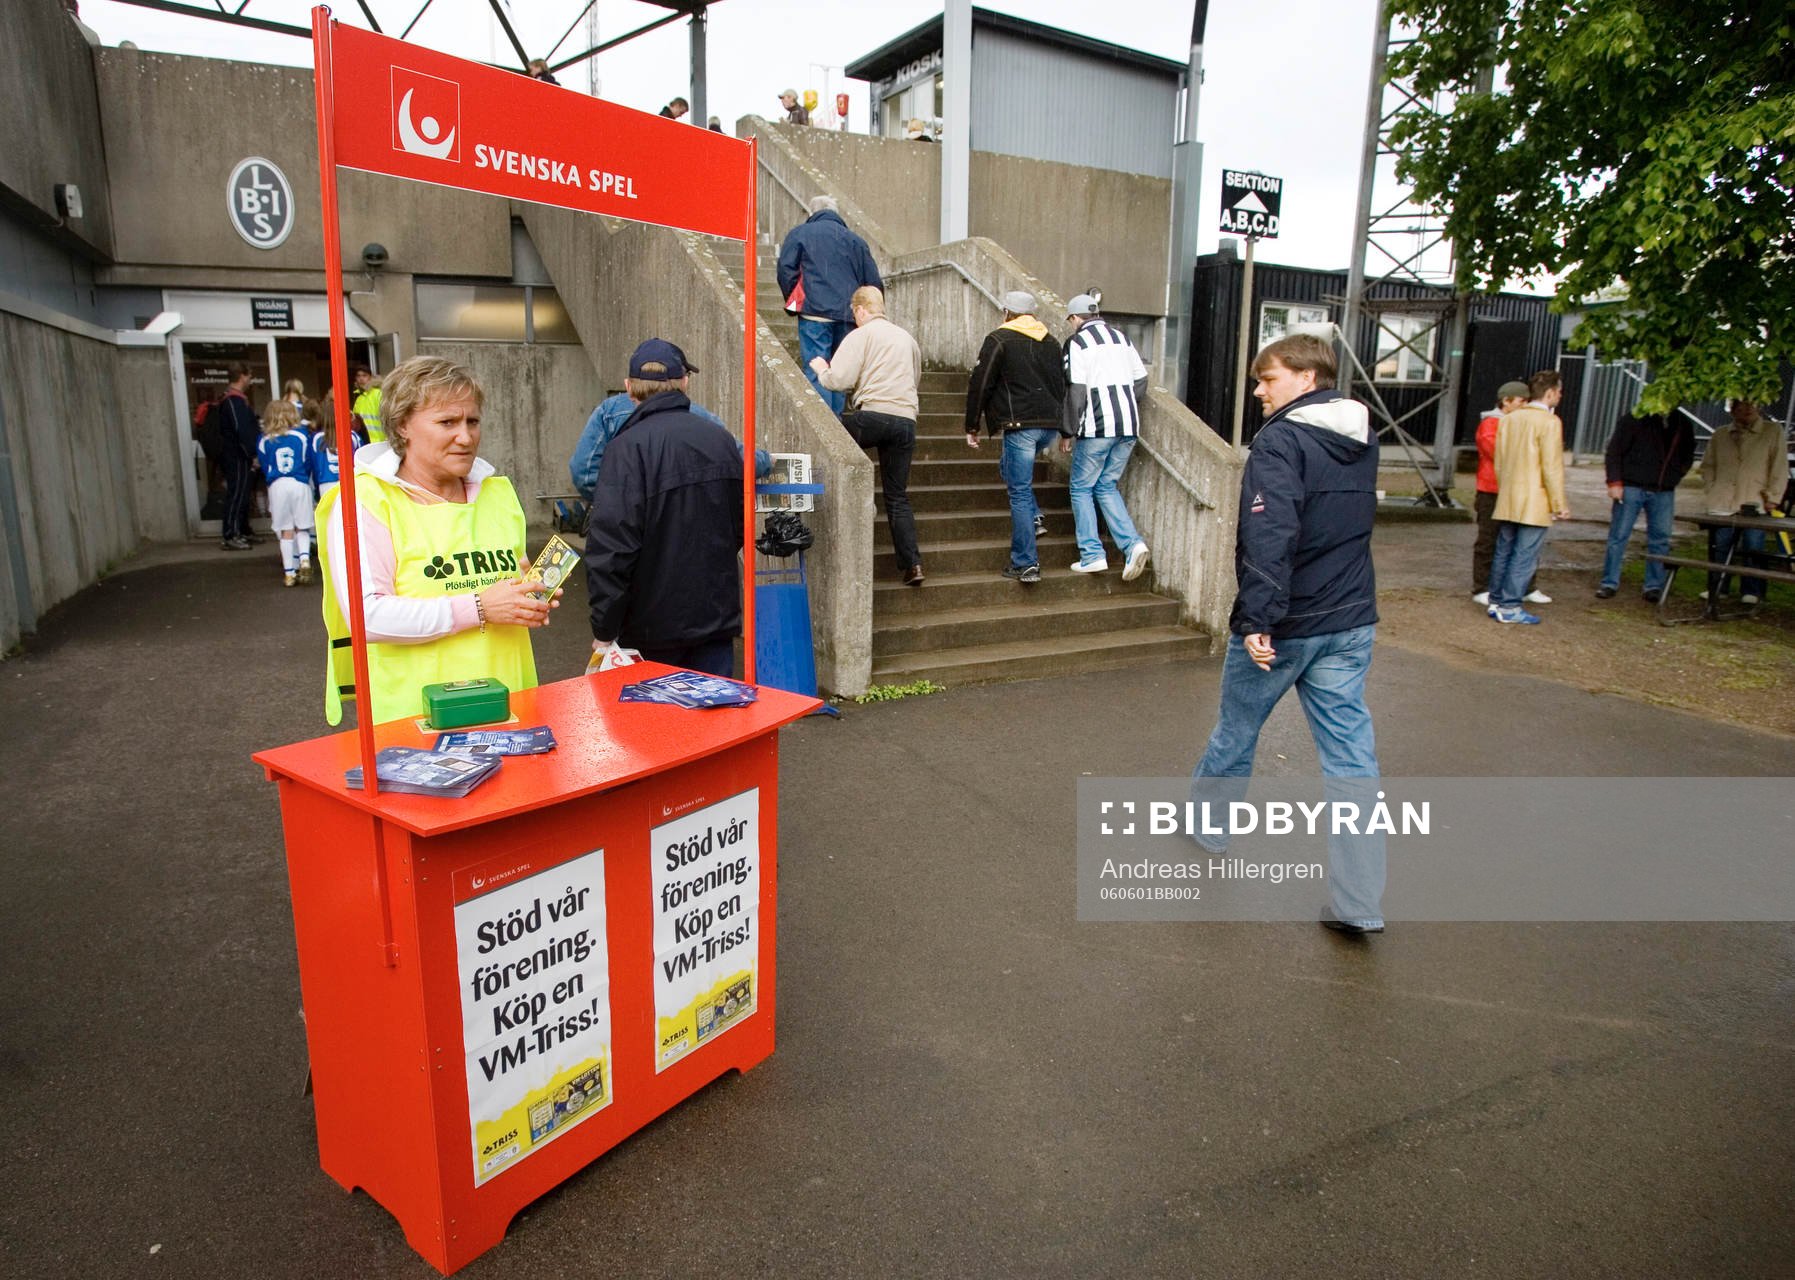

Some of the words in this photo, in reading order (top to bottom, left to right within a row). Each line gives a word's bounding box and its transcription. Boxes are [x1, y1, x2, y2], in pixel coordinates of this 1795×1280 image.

[896, 48, 944, 85] KIOSK
[474, 143, 582, 188] SVENSKA
[589, 169, 638, 199] SPEL
[1225, 171, 1280, 194] SEKTION
[1220, 208, 1279, 236] A,B,C,D
[275, 446, 295, 474] 6
[453, 549, 517, 576] TRISS
[445, 579, 479, 591] Plötsligt
[666, 826, 713, 872] Stöd
[716, 817, 748, 849] vår
[488, 868, 517, 884] SVENSKA
[516, 863, 531, 873] SPEL
[661, 856, 752, 913] förening.
[477, 898, 542, 954] Stöd
[547, 886, 590, 923] vår
[674, 908, 713, 944] Köp
[717, 894, 741, 921] en
[471, 929, 596, 1002] förening.
[663, 916, 750, 983] VM-Triss!
[493, 993, 546, 1036] Köp
[552, 973, 584, 1005] en
[478, 997, 599, 1082] VM-Triss!
[670, 1026, 689, 1043] TRISS
[493, 1128, 518, 1149] TRISS
